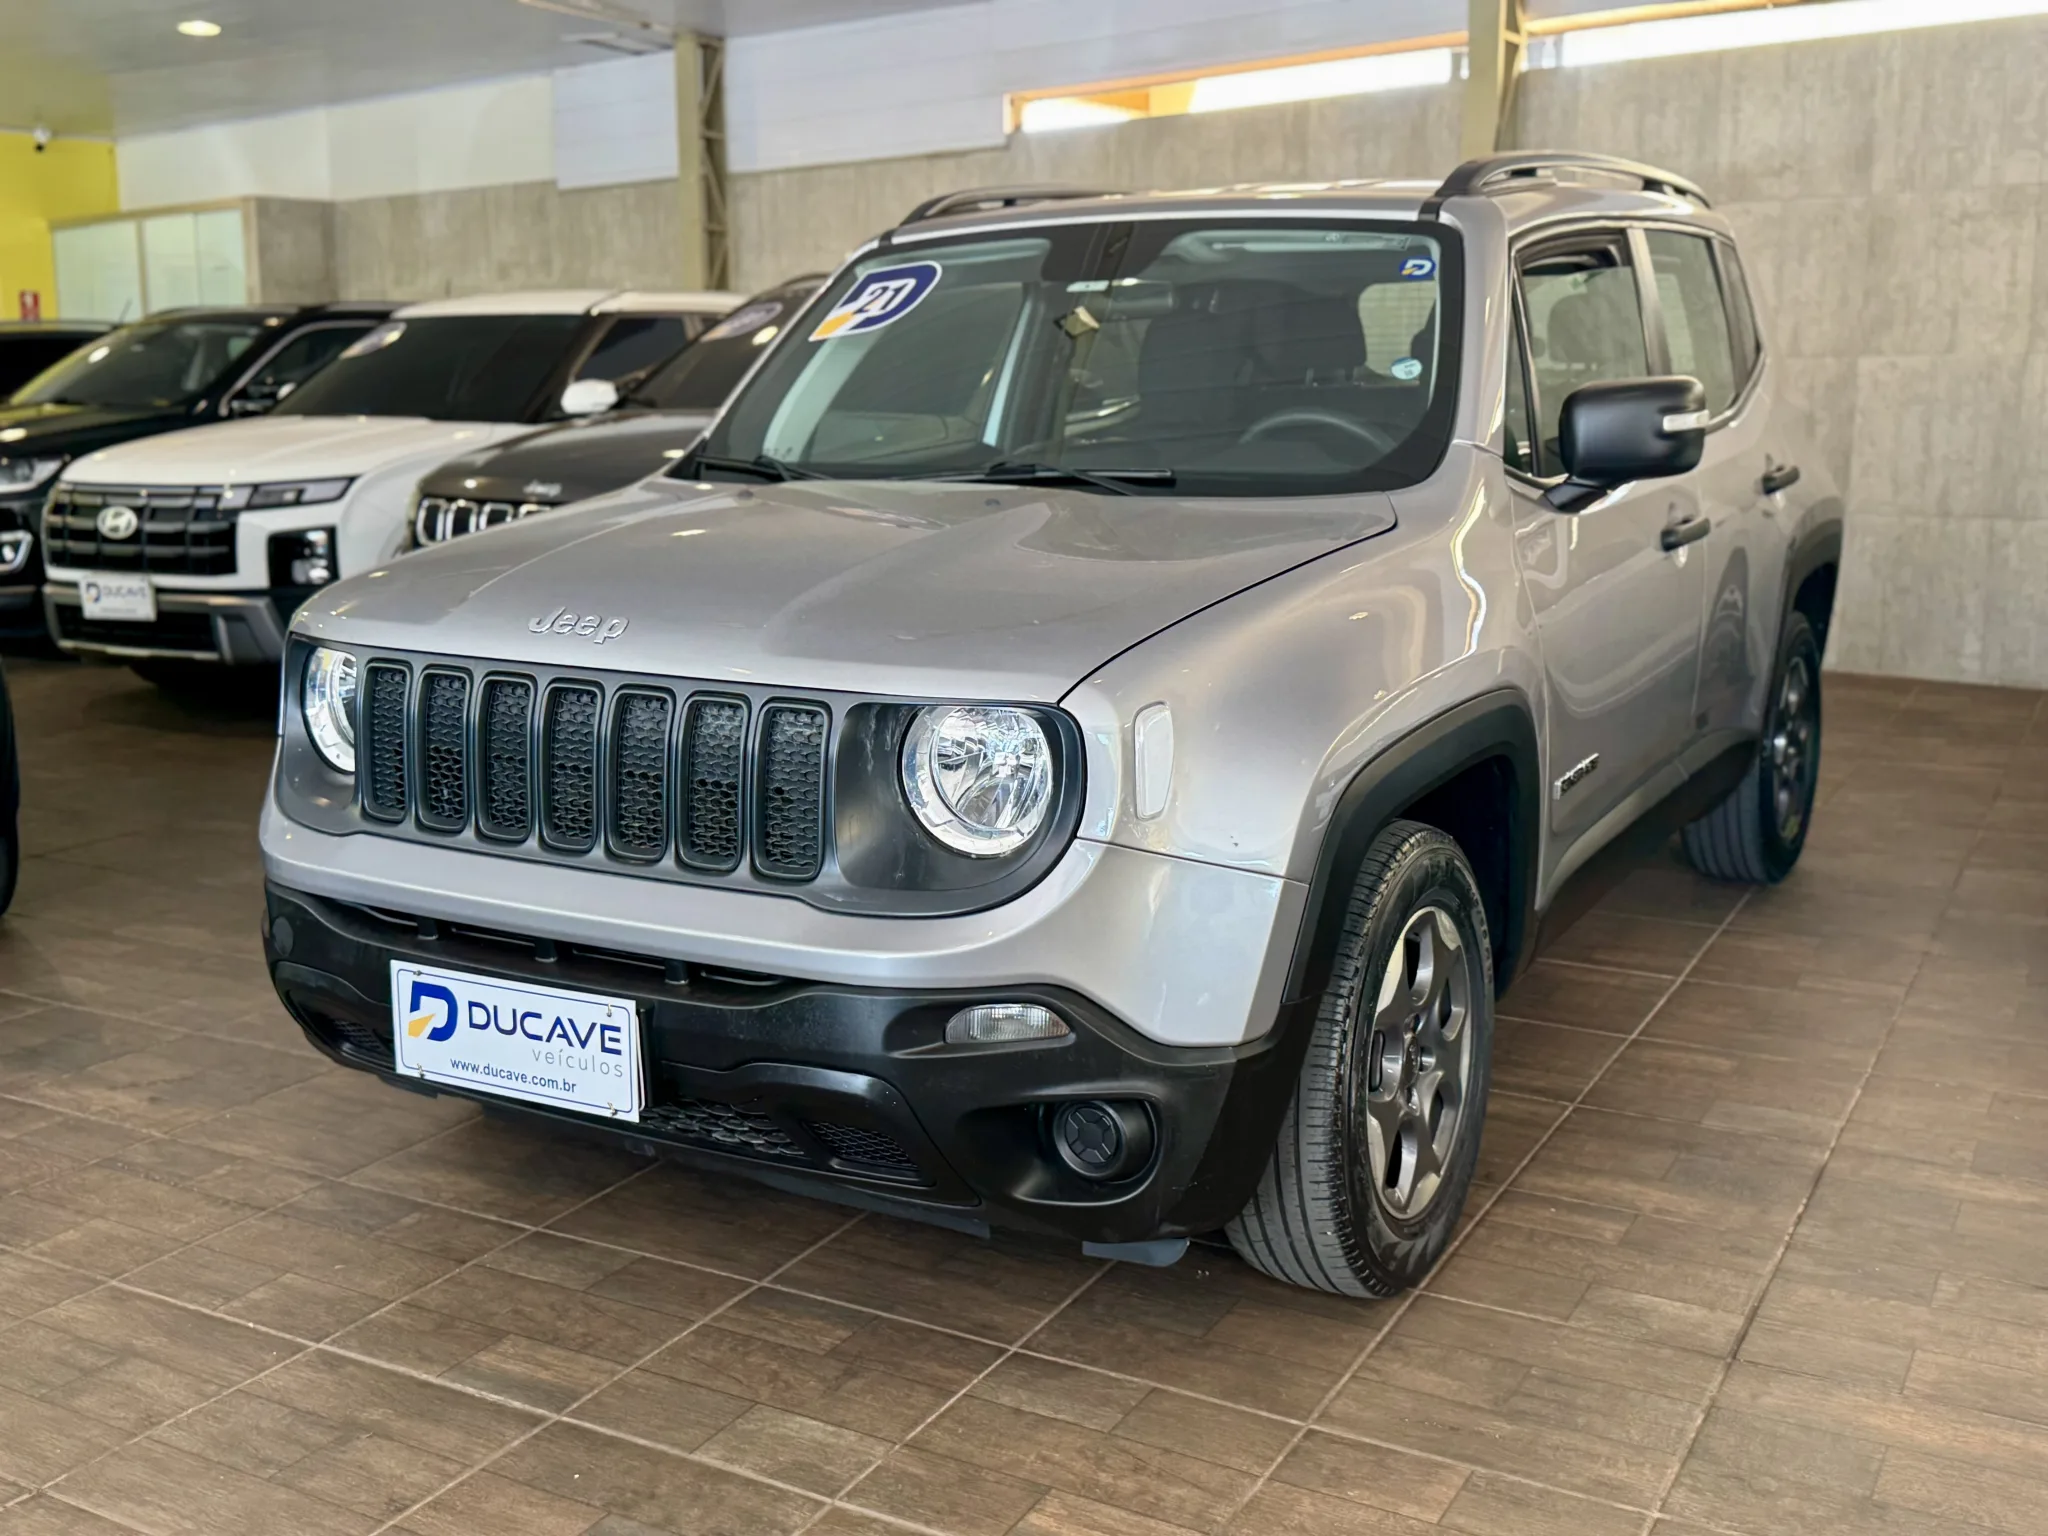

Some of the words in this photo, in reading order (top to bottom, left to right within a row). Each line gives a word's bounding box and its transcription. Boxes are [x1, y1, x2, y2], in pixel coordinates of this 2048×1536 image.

[852, 282, 908, 315] 21
[528, 606, 630, 645] Jeep
[467, 1000, 622, 1056] DUCAVE
[450, 1058, 577, 1093] www.ducave.com.br
[532, 1048, 623, 1077] veículos
